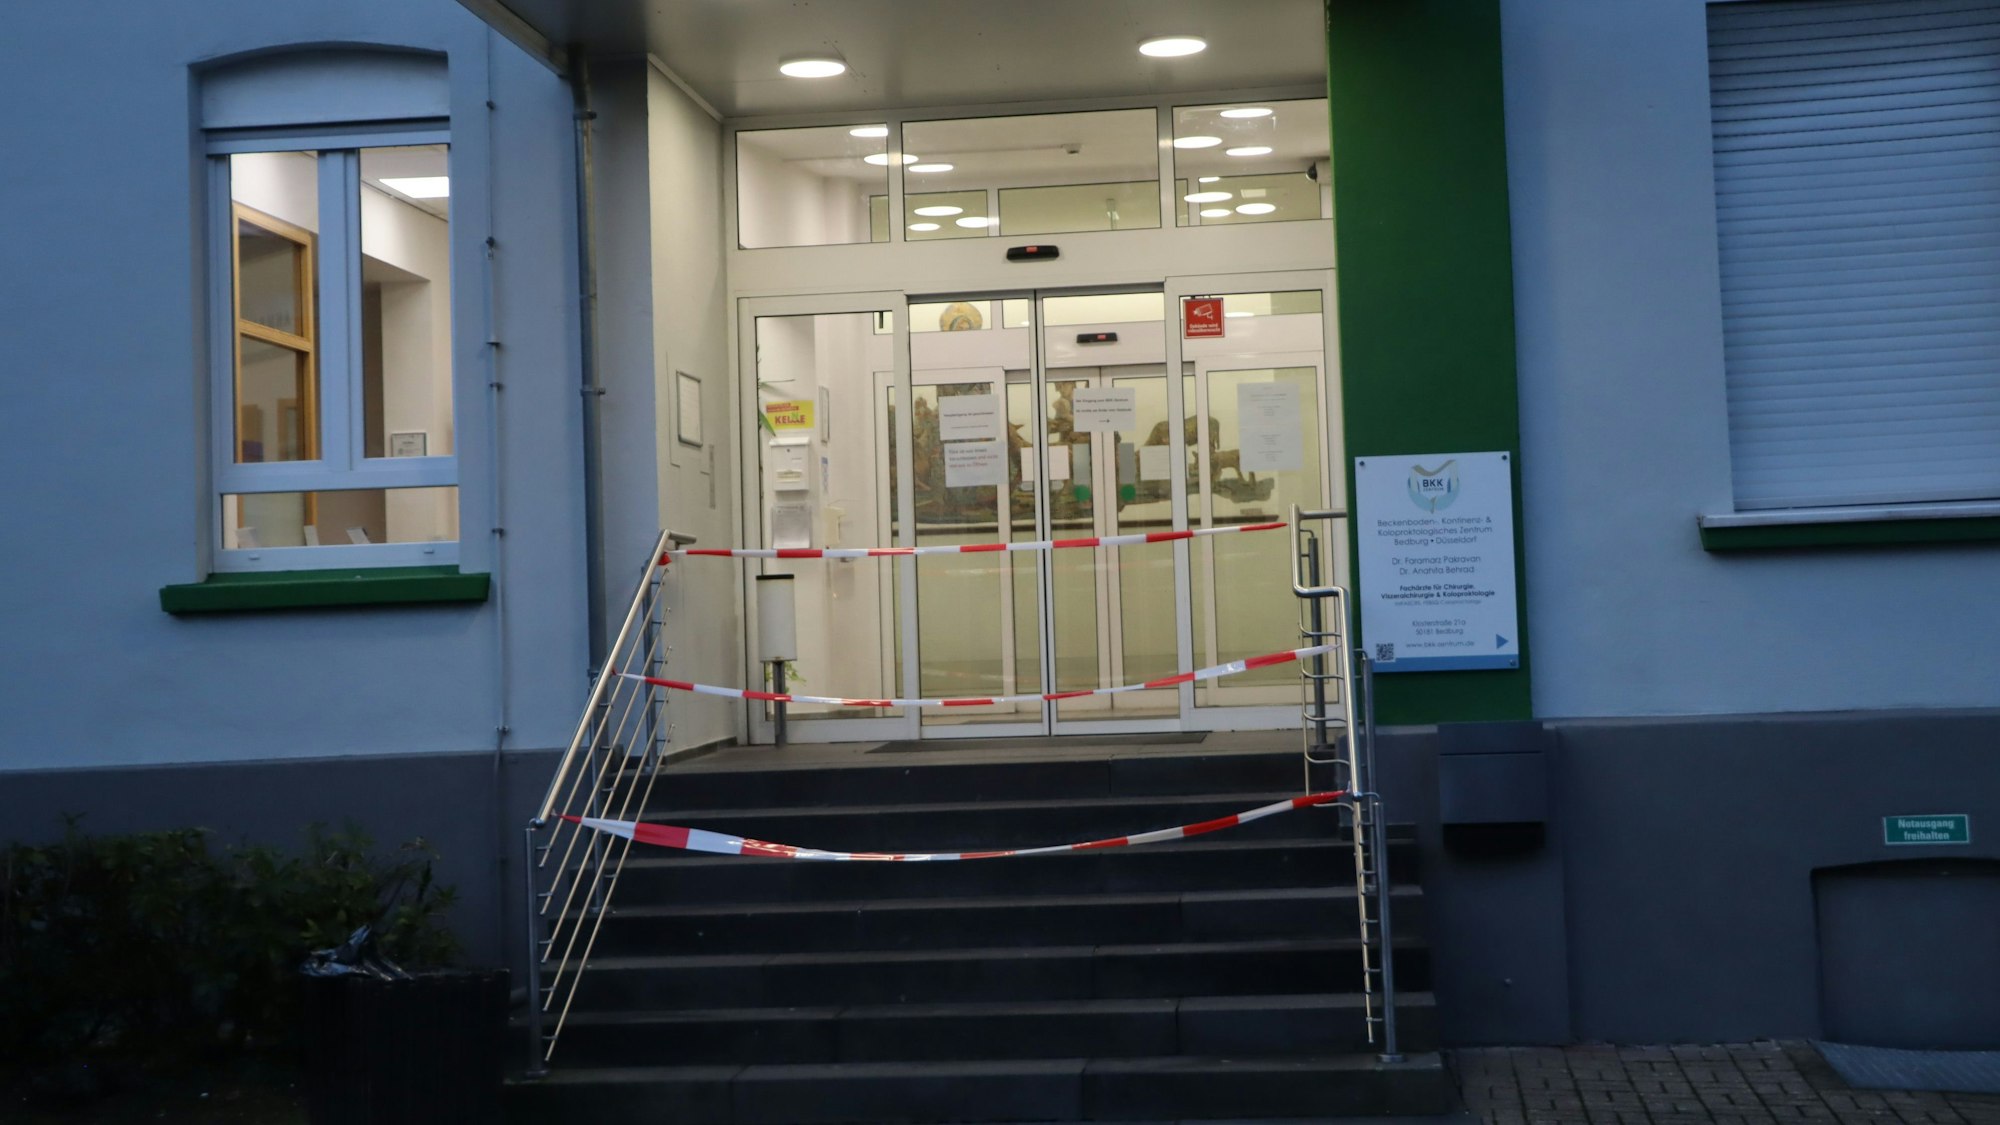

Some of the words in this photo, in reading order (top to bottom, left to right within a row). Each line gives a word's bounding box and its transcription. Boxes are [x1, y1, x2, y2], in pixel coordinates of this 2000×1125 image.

[1422, 478, 1444, 488] BKK
[1441, 517, 1483, 526] Kontinenz-
[1377, 527, 1457, 538] Koloproktologisches
[1459, 525, 1493, 534] Zentrum
[1394, 537, 1429, 546] Bedburg
[1435, 536, 1478, 545] Düsseldorf
[1392, 557, 1402, 565] Dr.
[1405, 556, 1442, 564] Faramarz
[1443, 555, 1481, 564] Pakravan
[1399, 567, 1410, 576] Dr.
[1412, 566, 1444, 575] Anahita
[1446, 566, 1475, 574] Behrad
[1399, 584, 1432, 592] Fachärzte
[1381, 591, 1434, 600] Viszeralchirurgie
[1443, 589, 1495, 598] Koloproktologie
[1435, 627, 1464, 636] Bedburg
[1898, 818, 1955, 830] Notausgang
[1903, 830, 1950, 841] freihalten
